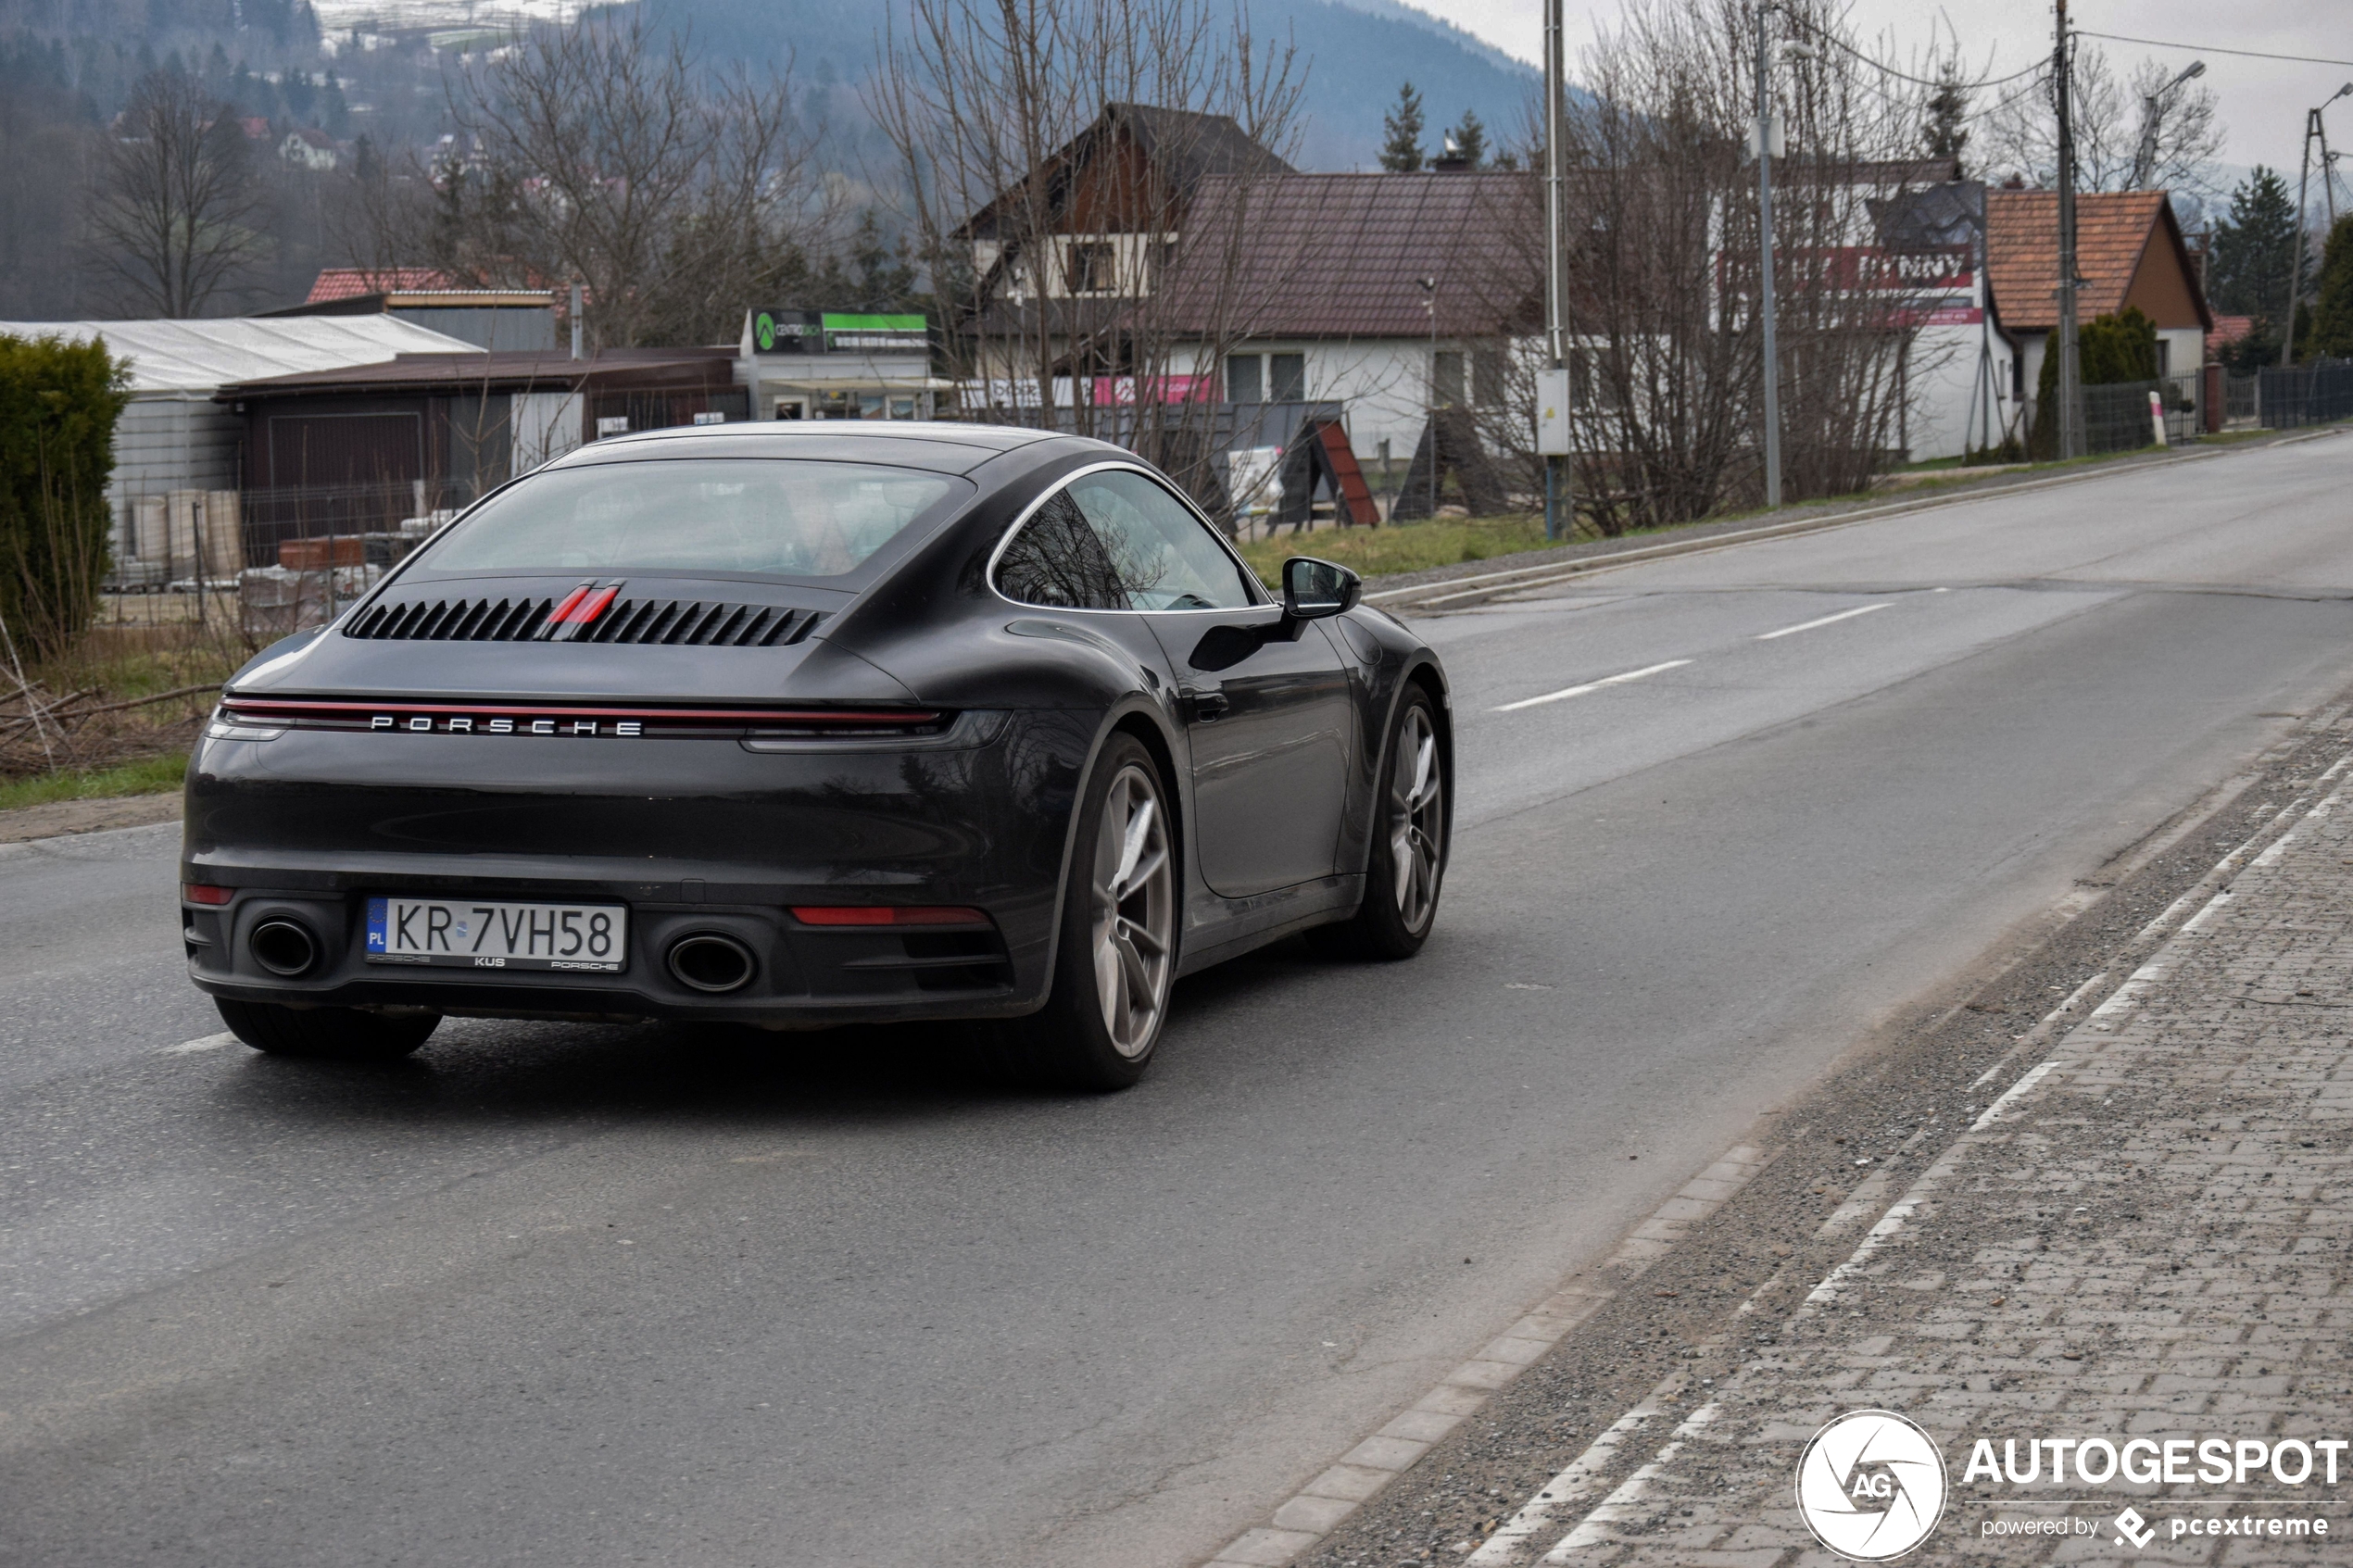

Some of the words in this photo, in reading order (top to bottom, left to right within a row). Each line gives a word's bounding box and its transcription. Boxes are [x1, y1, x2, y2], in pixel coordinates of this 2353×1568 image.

[371, 716, 642, 736] PORSCHE
[396, 904, 453, 951] KR
[471, 907, 611, 957] 7VH58
[369, 933, 384, 946] PL
[367, 954, 432, 963] PORSCHE
[474, 958, 506, 968] KUS
[551, 961, 619, 971] PORSCHE
